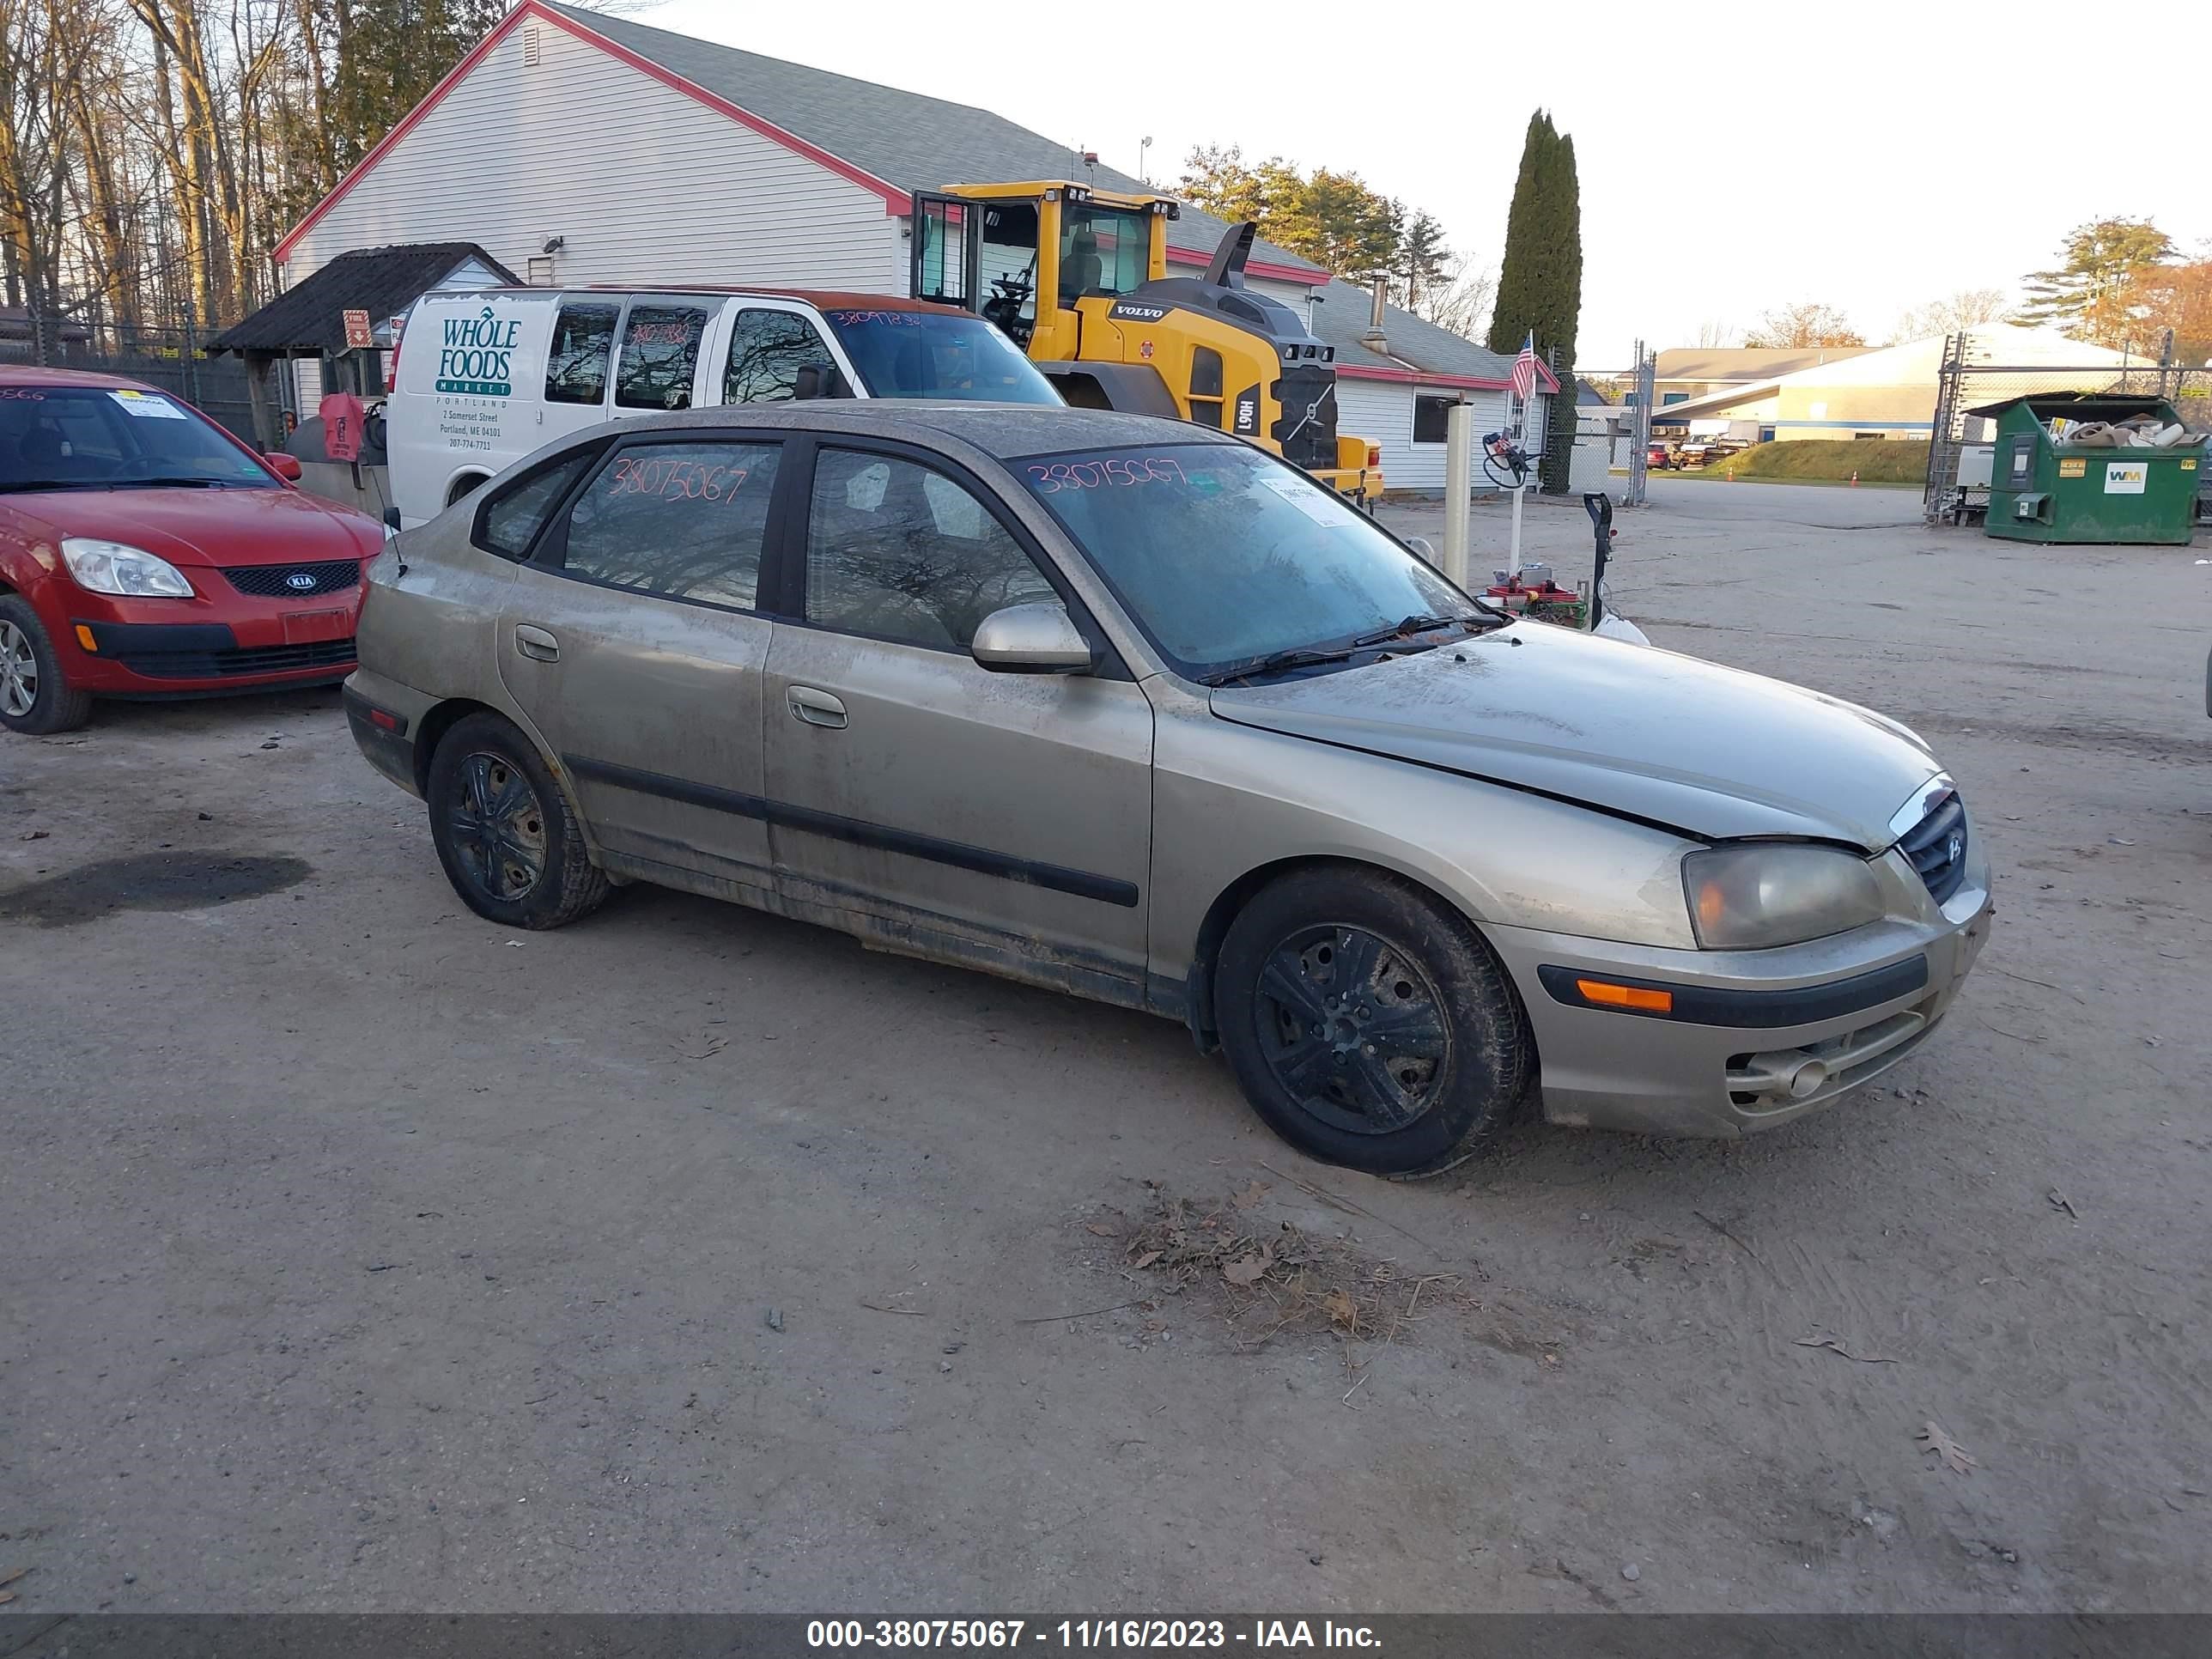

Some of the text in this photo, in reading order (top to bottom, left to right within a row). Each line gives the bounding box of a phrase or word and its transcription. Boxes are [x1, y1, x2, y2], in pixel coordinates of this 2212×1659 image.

[1117, 306, 1164, 318] VOLVO
[444, 319, 522, 349] WHOLE
[439, 349, 511, 380] FOODS
[440, 381, 506, 394] MARKET
[436, 397, 507, 409] PORTLAND
[443, 410, 498, 422] 2 Somerset Street
[1237, 400, 1255, 429] L90H
[440, 423, 501, 437] Portland, ME 04101
[449, 438, 491, 451] 207-774-7711
[610, 459, 747, 505] 38075067
[1028, 459, 1187, 493] 38075067
[2110, 471, 2141, 481] WM
[292, 577, 313, 586] KIA
